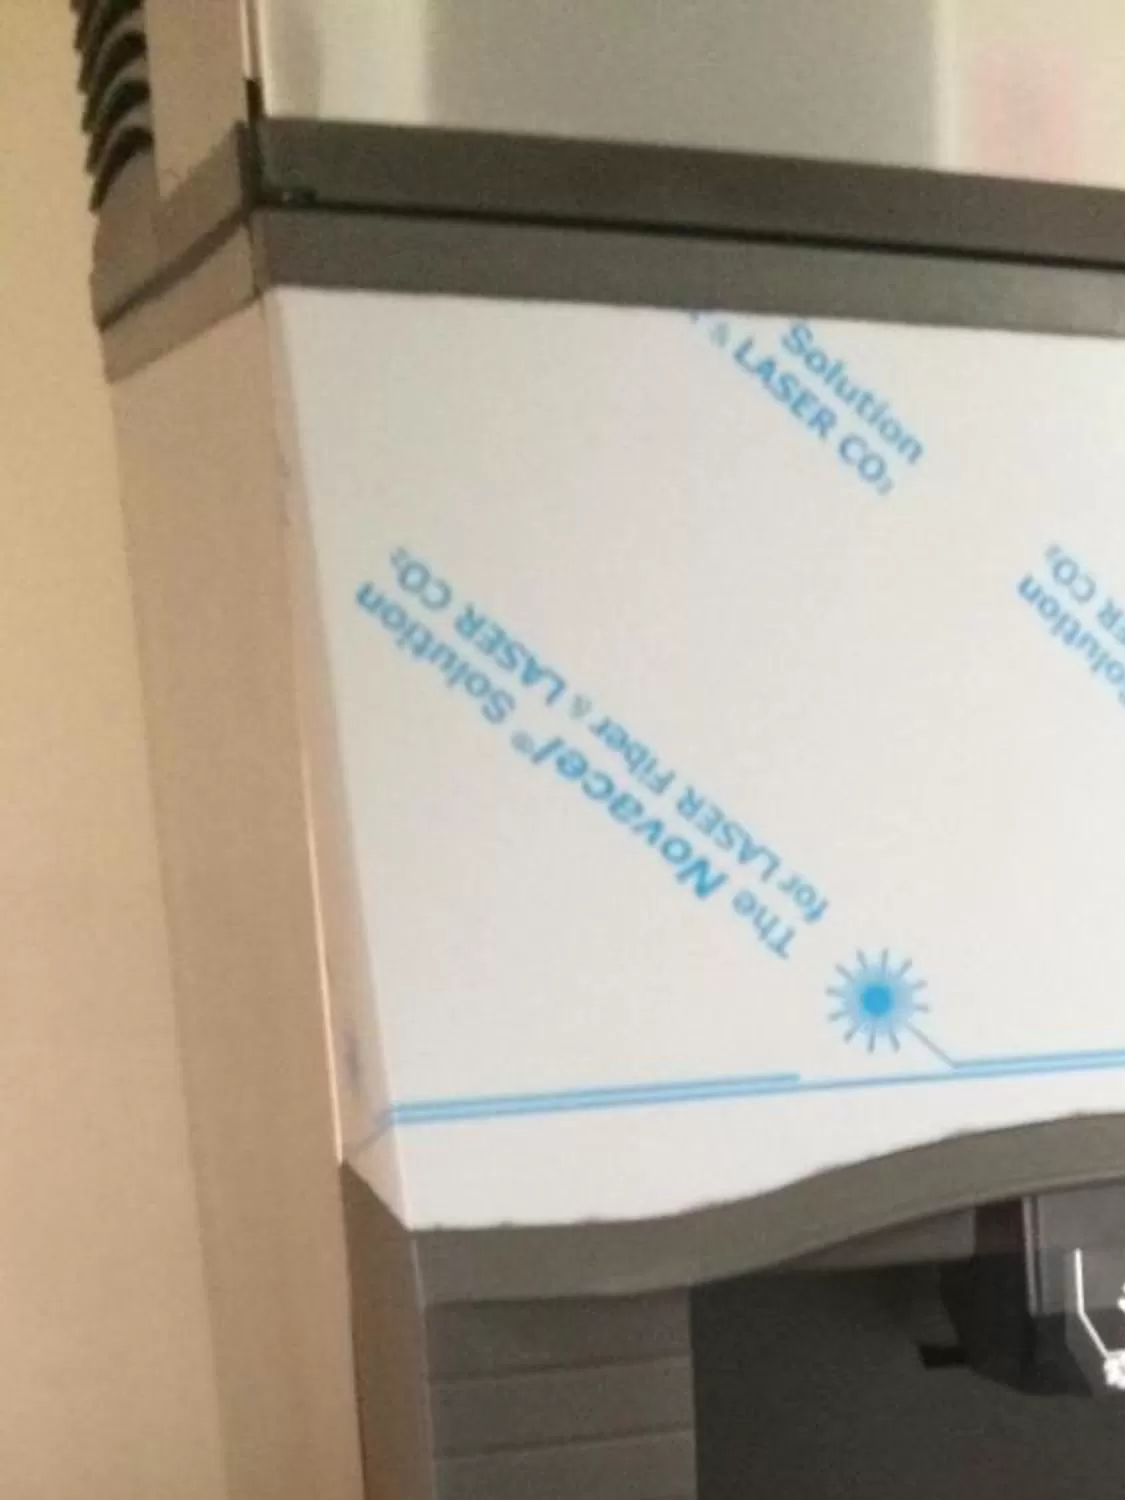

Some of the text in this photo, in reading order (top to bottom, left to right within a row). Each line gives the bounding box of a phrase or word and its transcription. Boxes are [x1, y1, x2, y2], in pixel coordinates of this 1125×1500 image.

[732, 334, 838, 441] LASER
[782, 318, 924, 465] Solution
[355, 580, 517, 726] Solution
[454, 602, 567, 706] LASER
[588, 713, 676, 797] Fiber
[675, 785, 781, 884] LASER
[732, 888, 796, 960] The
[777, 873, 829, 924] for
